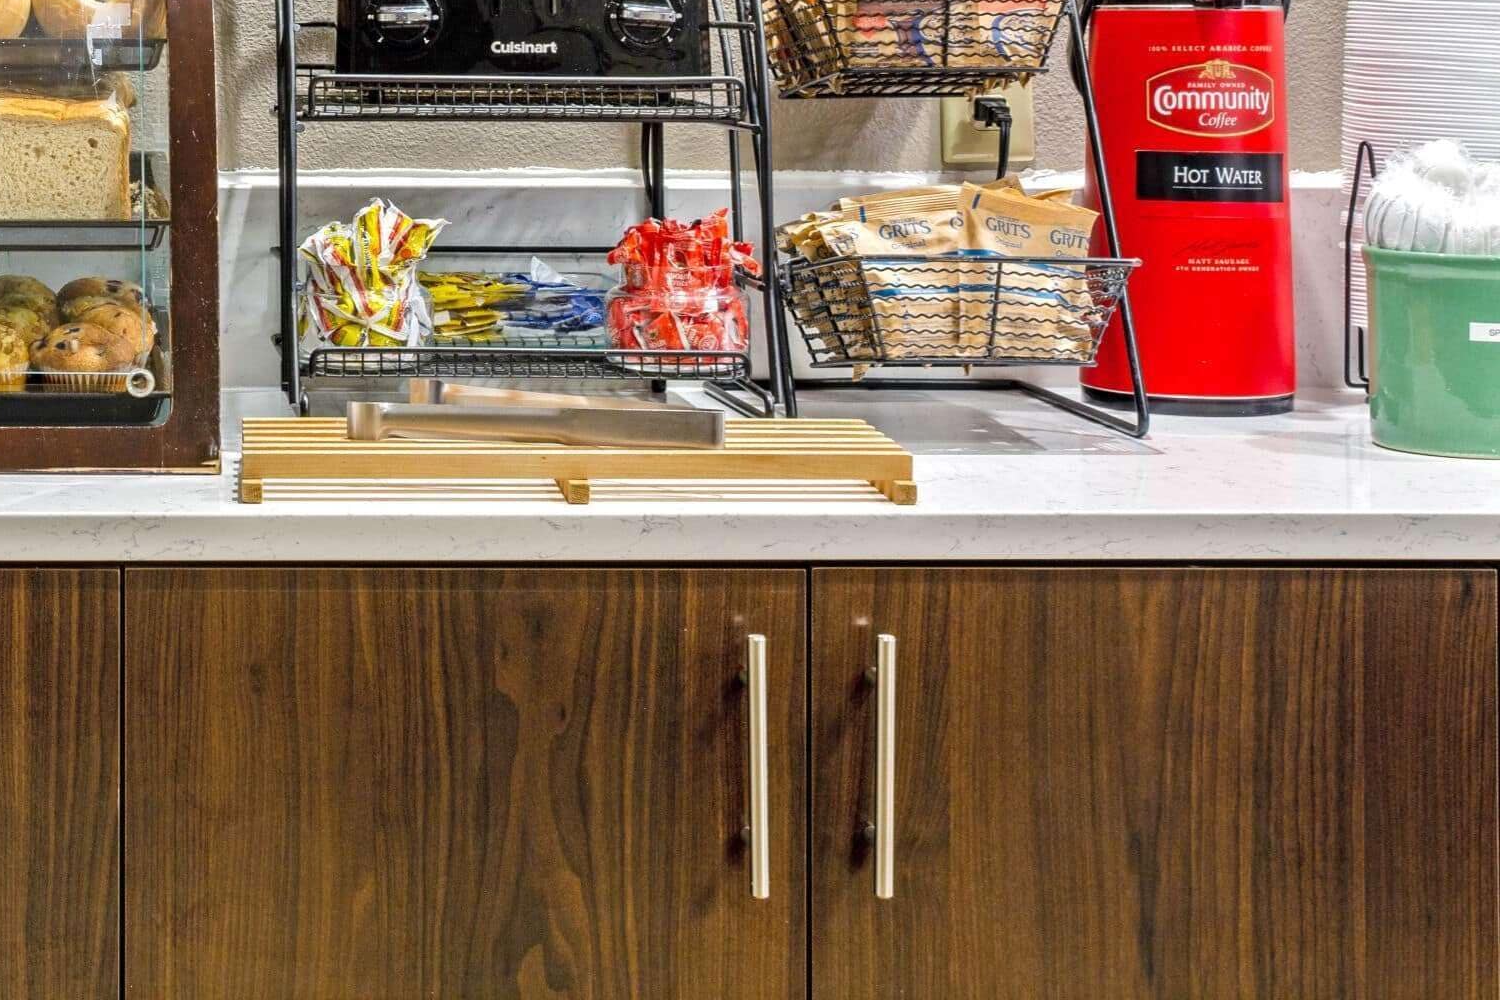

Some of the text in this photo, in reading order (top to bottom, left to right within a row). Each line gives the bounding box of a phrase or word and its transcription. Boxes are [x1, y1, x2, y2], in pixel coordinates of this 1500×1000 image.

[491, 41, 558, 53] Cuisinart
[1154, 85, 1270, 116] Community
[1198, 112, 1238, 128] Coffee
[879, 220, 932, 240] GRITS
[985, 216, 1031, 239] GRITS
